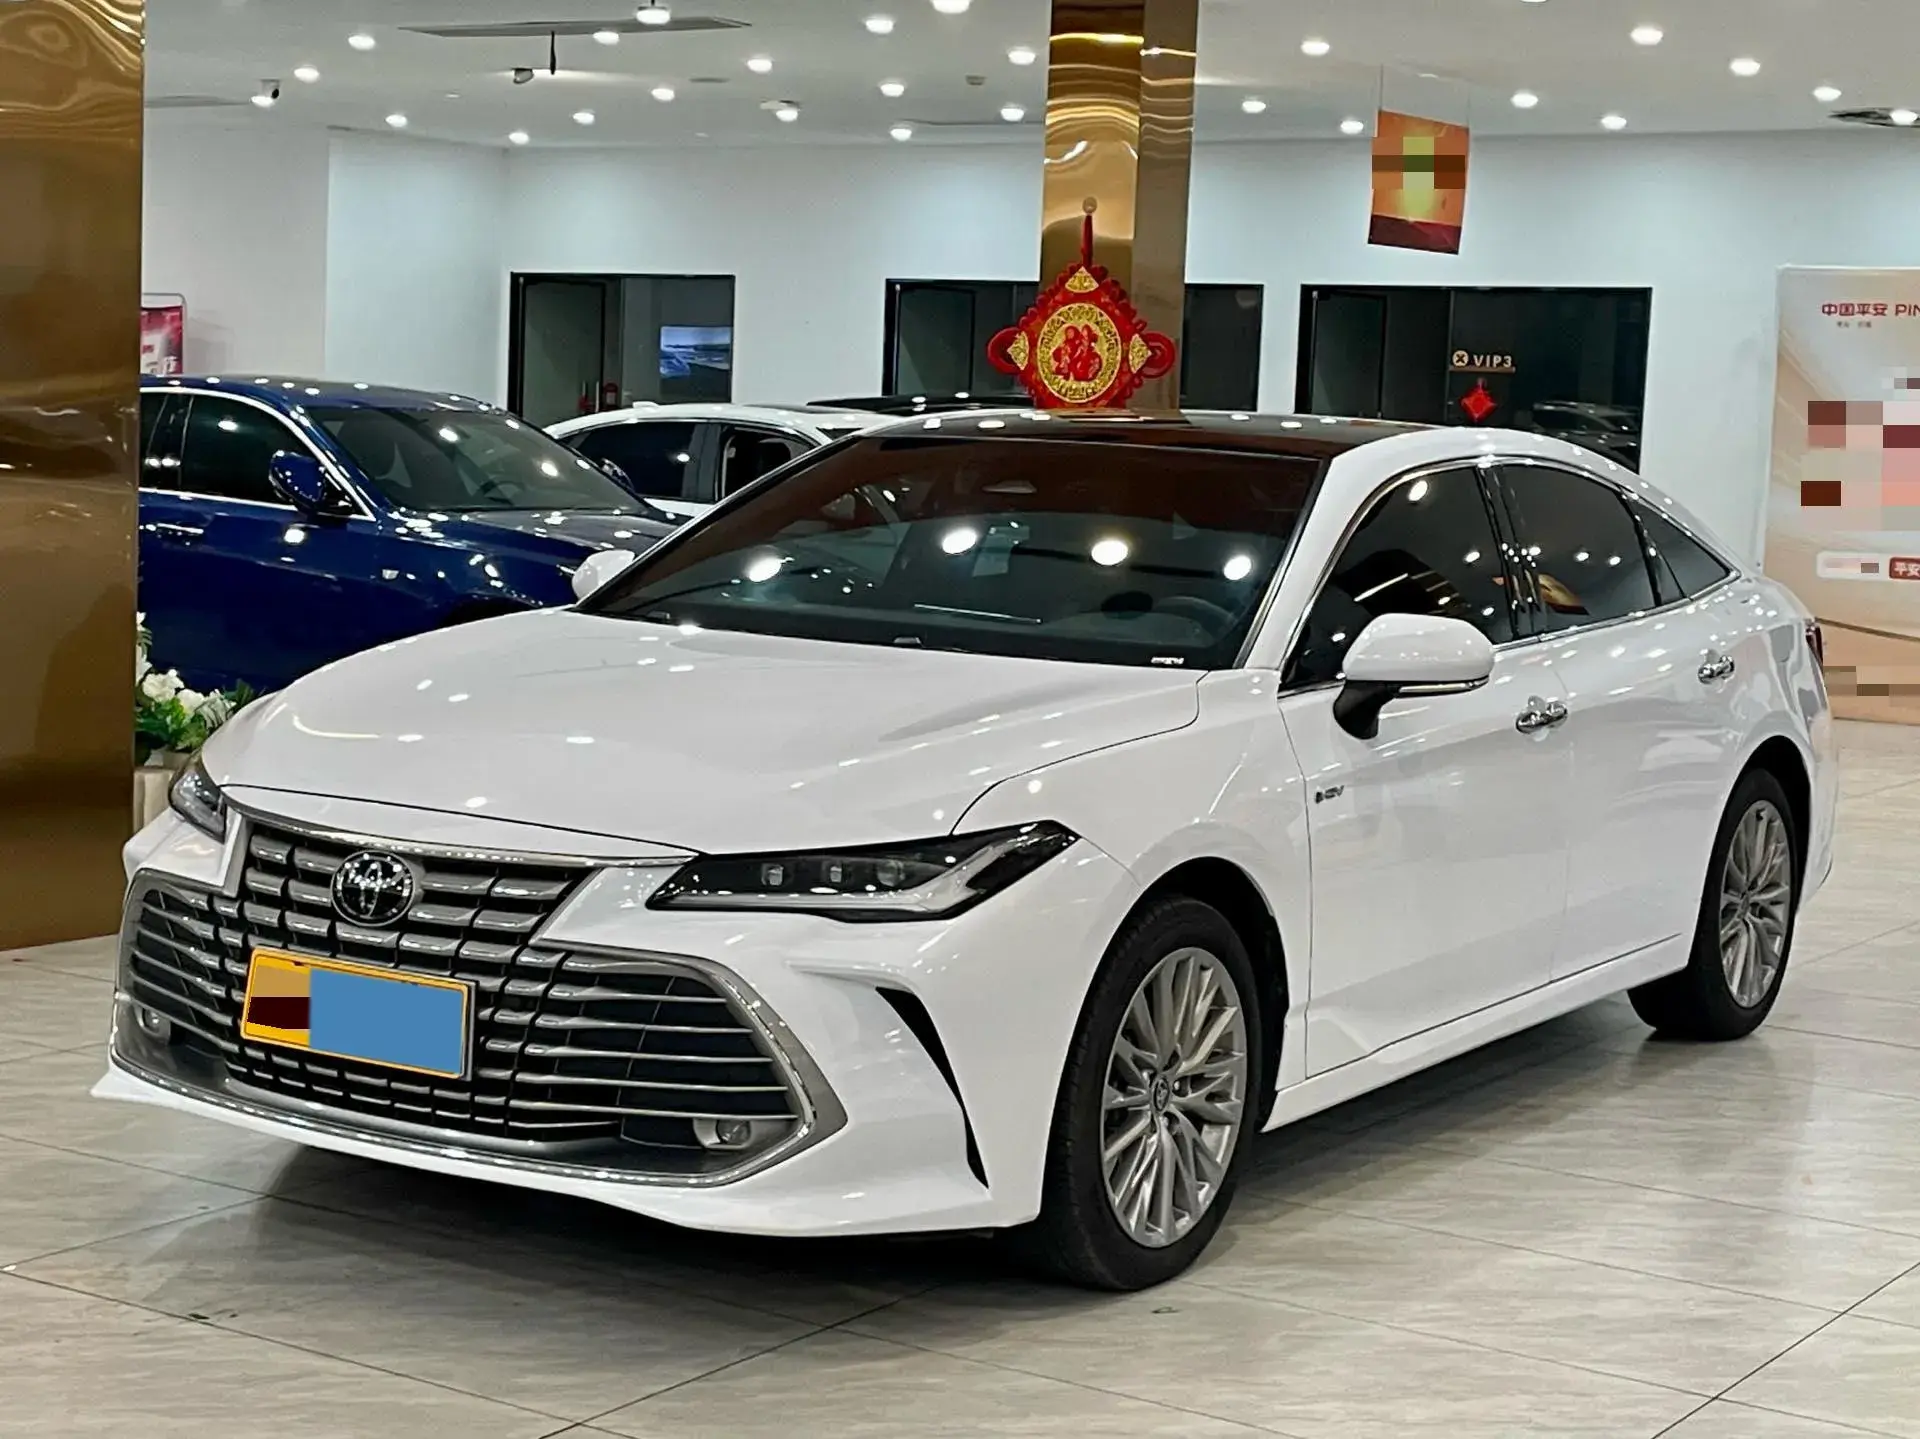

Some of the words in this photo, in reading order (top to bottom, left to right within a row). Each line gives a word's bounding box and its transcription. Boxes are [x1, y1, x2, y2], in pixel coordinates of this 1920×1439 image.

[1821, 303, 1888, 317] 中国平安
[1473, 354, 1512, 368] VIP3
